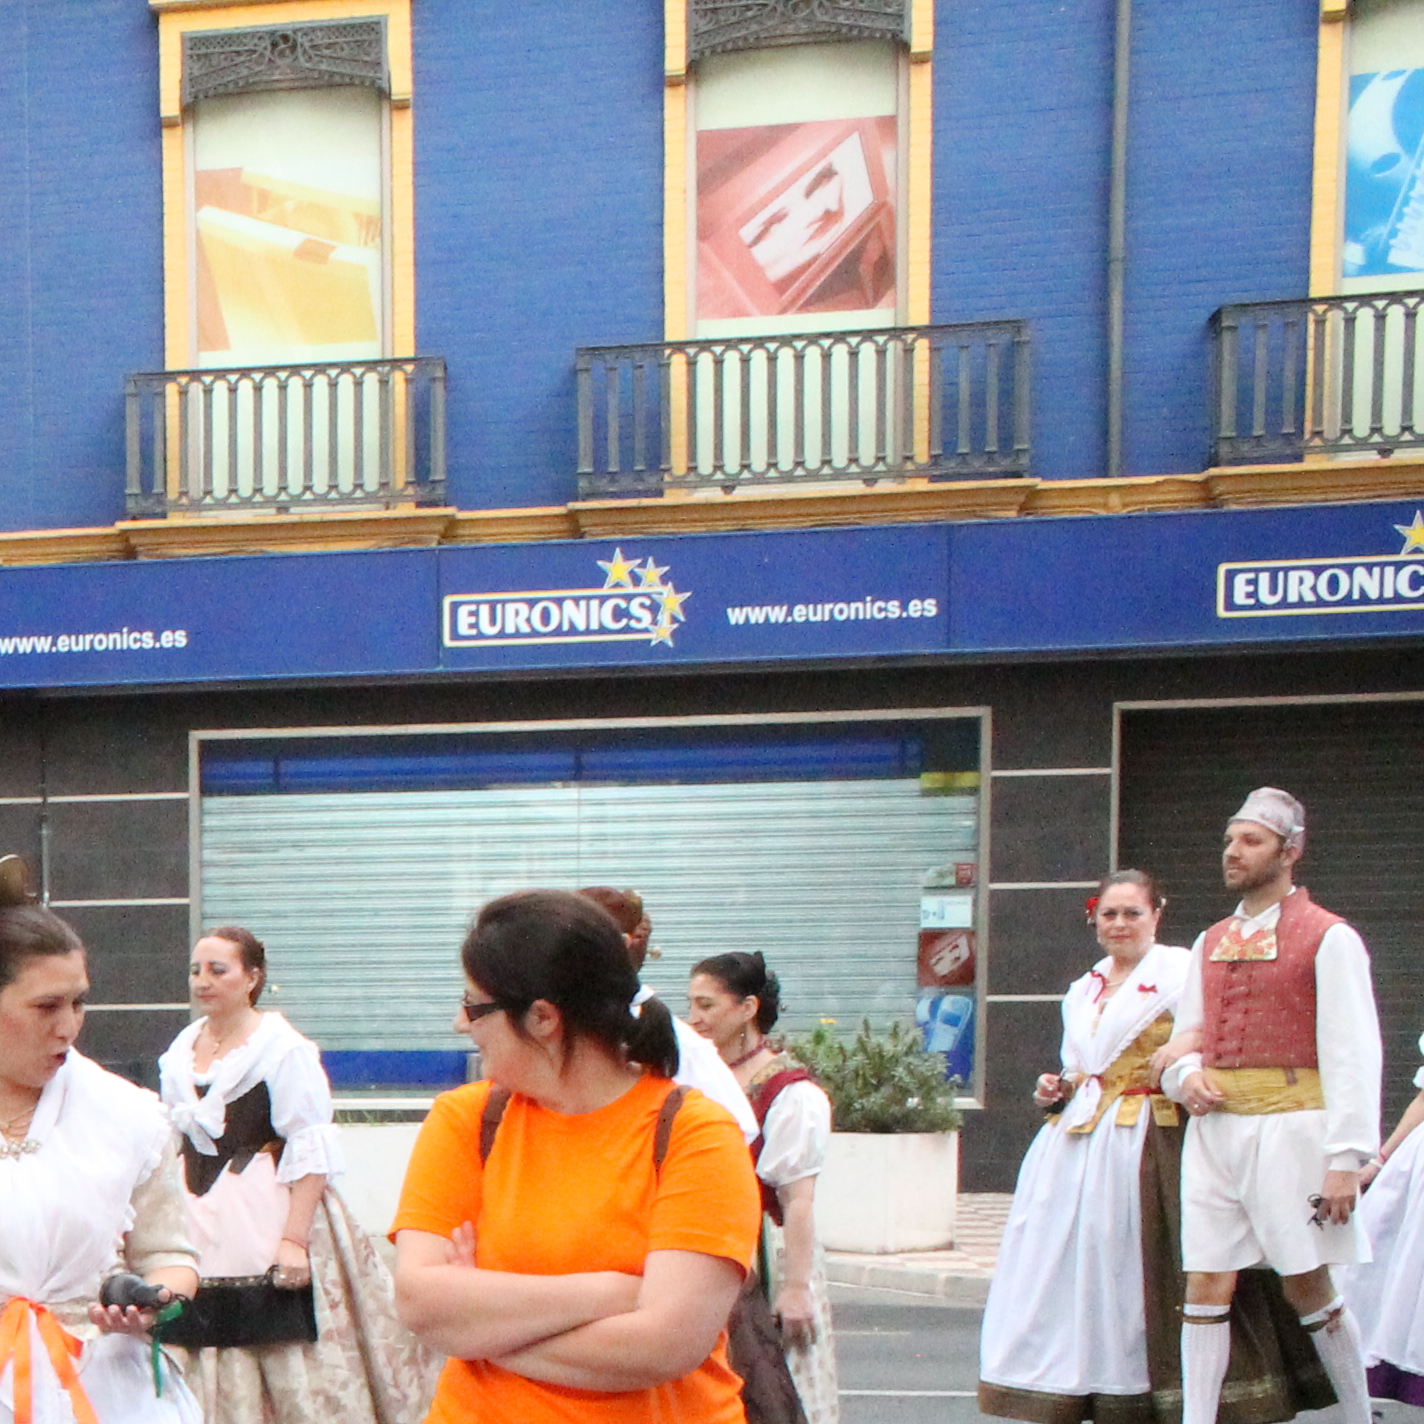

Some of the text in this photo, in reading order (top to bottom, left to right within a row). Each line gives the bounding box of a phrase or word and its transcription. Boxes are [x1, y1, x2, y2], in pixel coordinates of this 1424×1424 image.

[1233, 564, 1424, 605] EURONIC
[457, 596, 938, 636] EURONICS www.euronics.es
